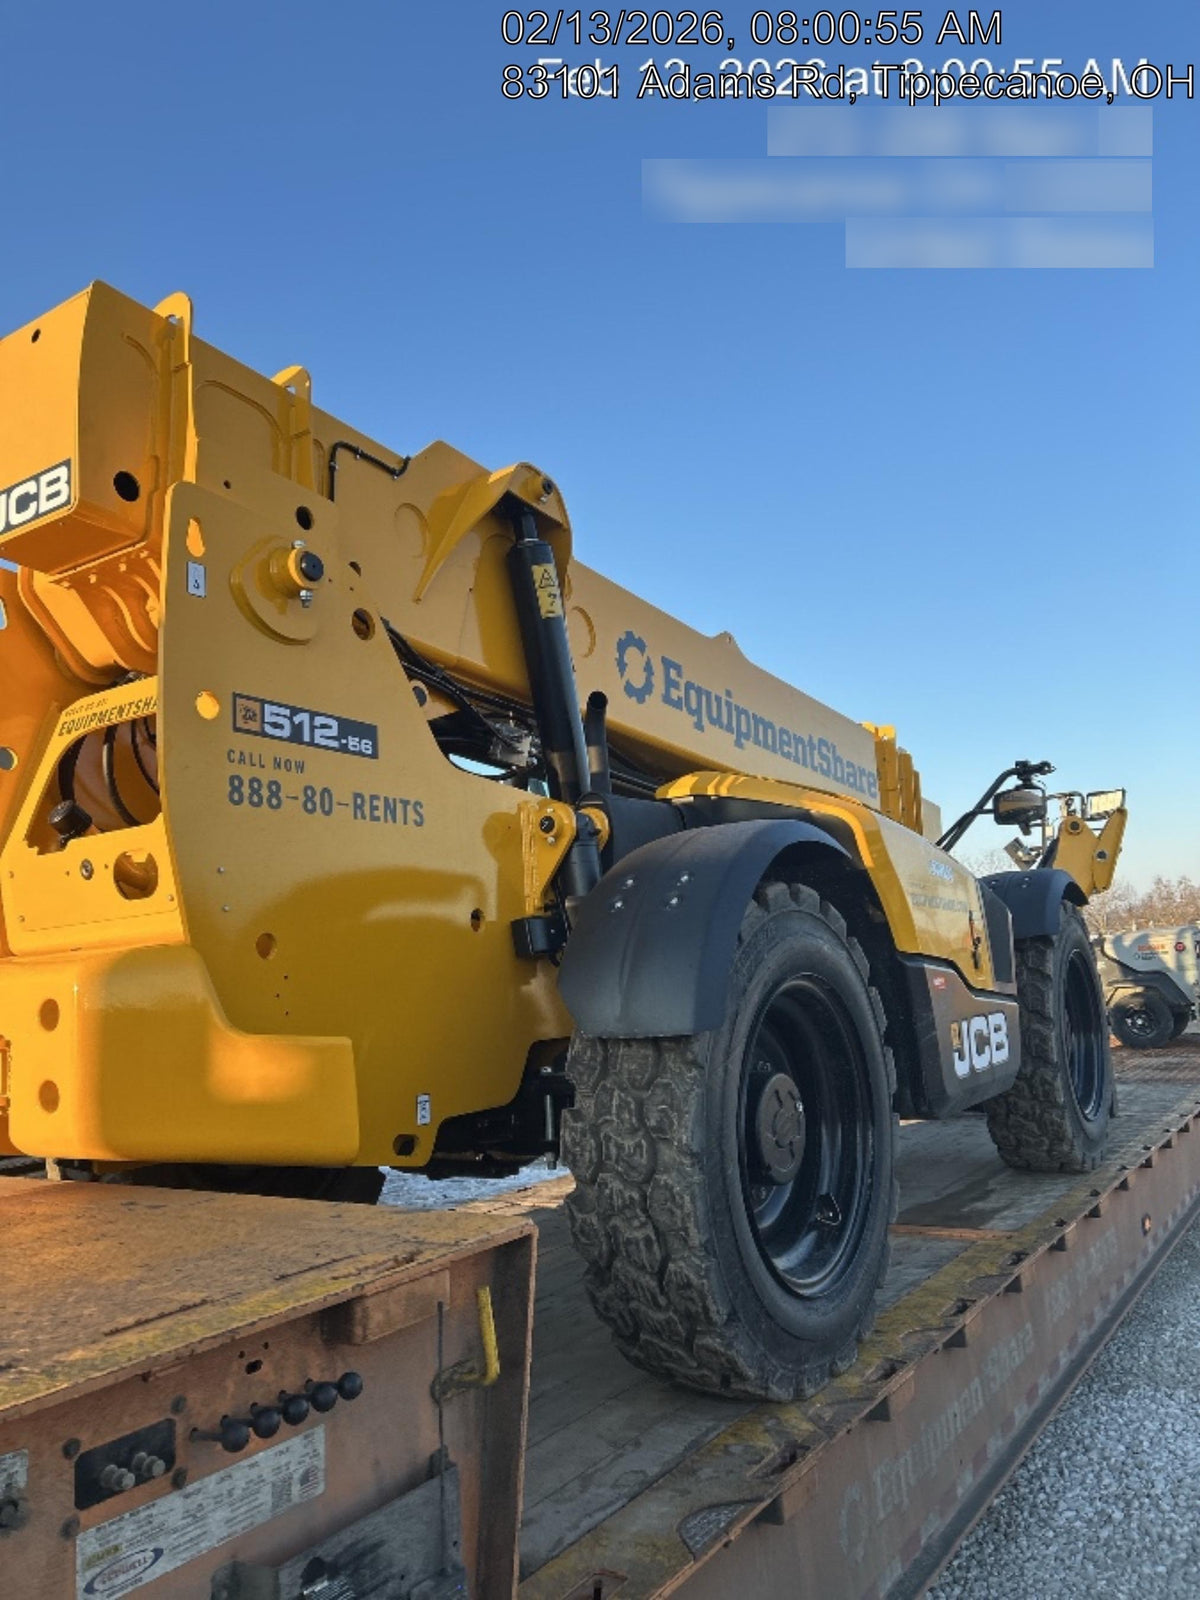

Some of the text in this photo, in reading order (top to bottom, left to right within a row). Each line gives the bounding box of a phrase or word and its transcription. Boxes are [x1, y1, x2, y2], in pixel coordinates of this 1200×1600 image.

[661, 656, 879, 799] EquipmentShare
[227, 749, 305, 774] CALL NOW
[228, 774, 425, 827] 888-80-RENTS
[951, 1012, 1010, 1080] JCB
